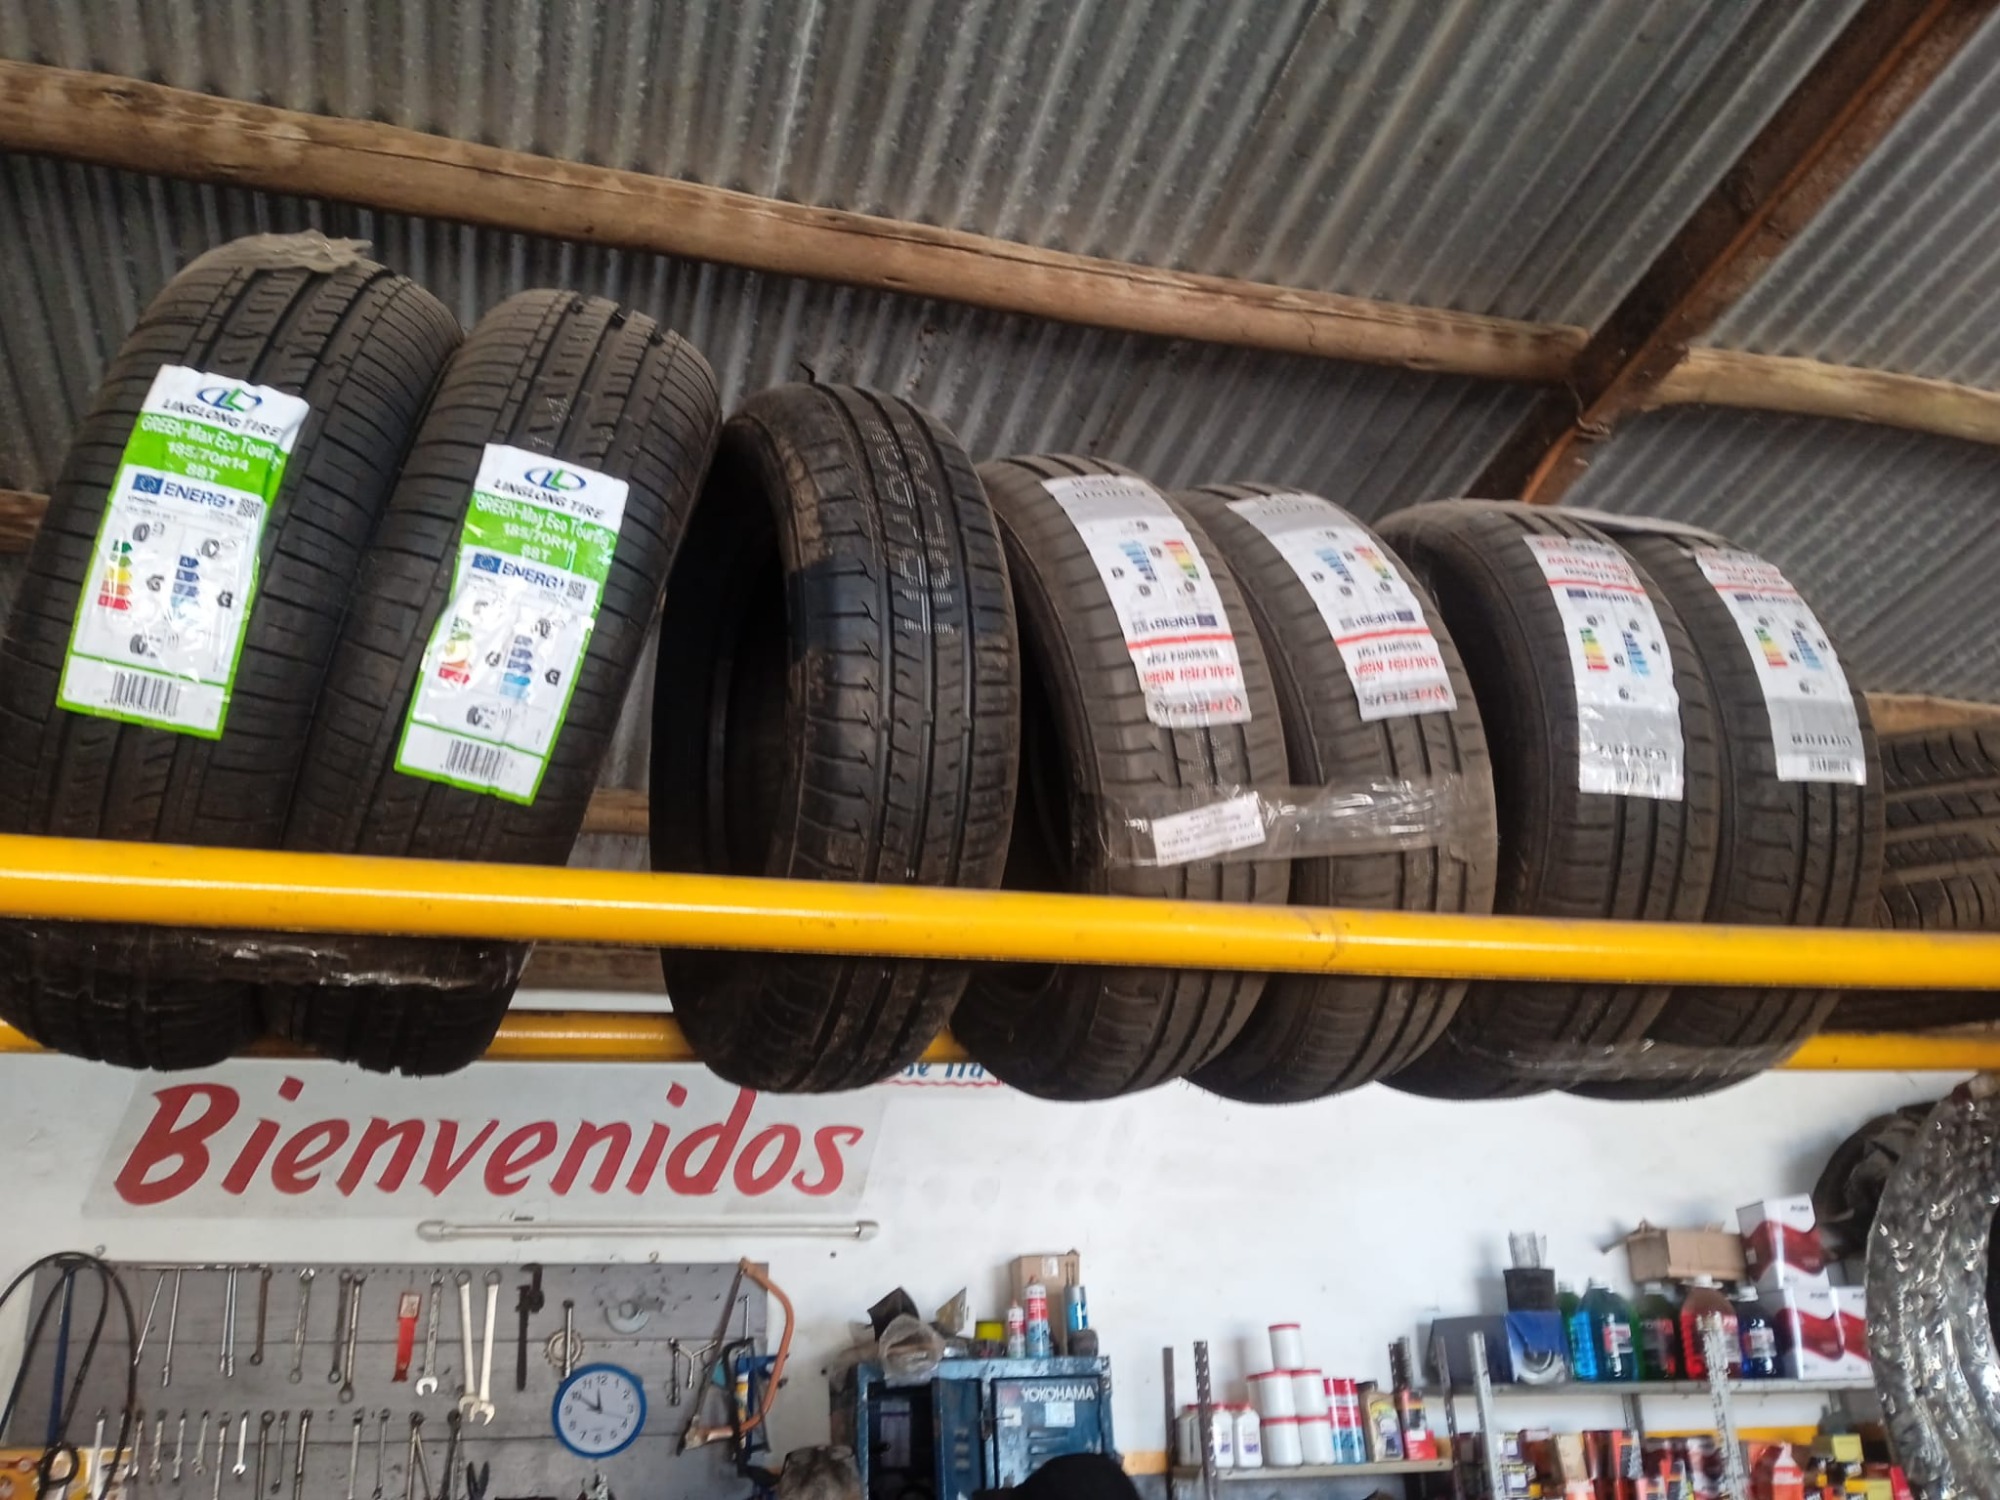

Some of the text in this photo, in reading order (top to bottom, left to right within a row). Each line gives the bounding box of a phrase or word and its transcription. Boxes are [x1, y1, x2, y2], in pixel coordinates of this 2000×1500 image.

[162, 399, 284, 438] LINGLONG TIRE
[214, 431, 240, 452] Eco
[494, 479, 606, 519] LINGLONG TIRE
[113, 1076, 863, 1206] Bienvenidos
[1021, 1385, 1095, 1402] YOKOHAMA
